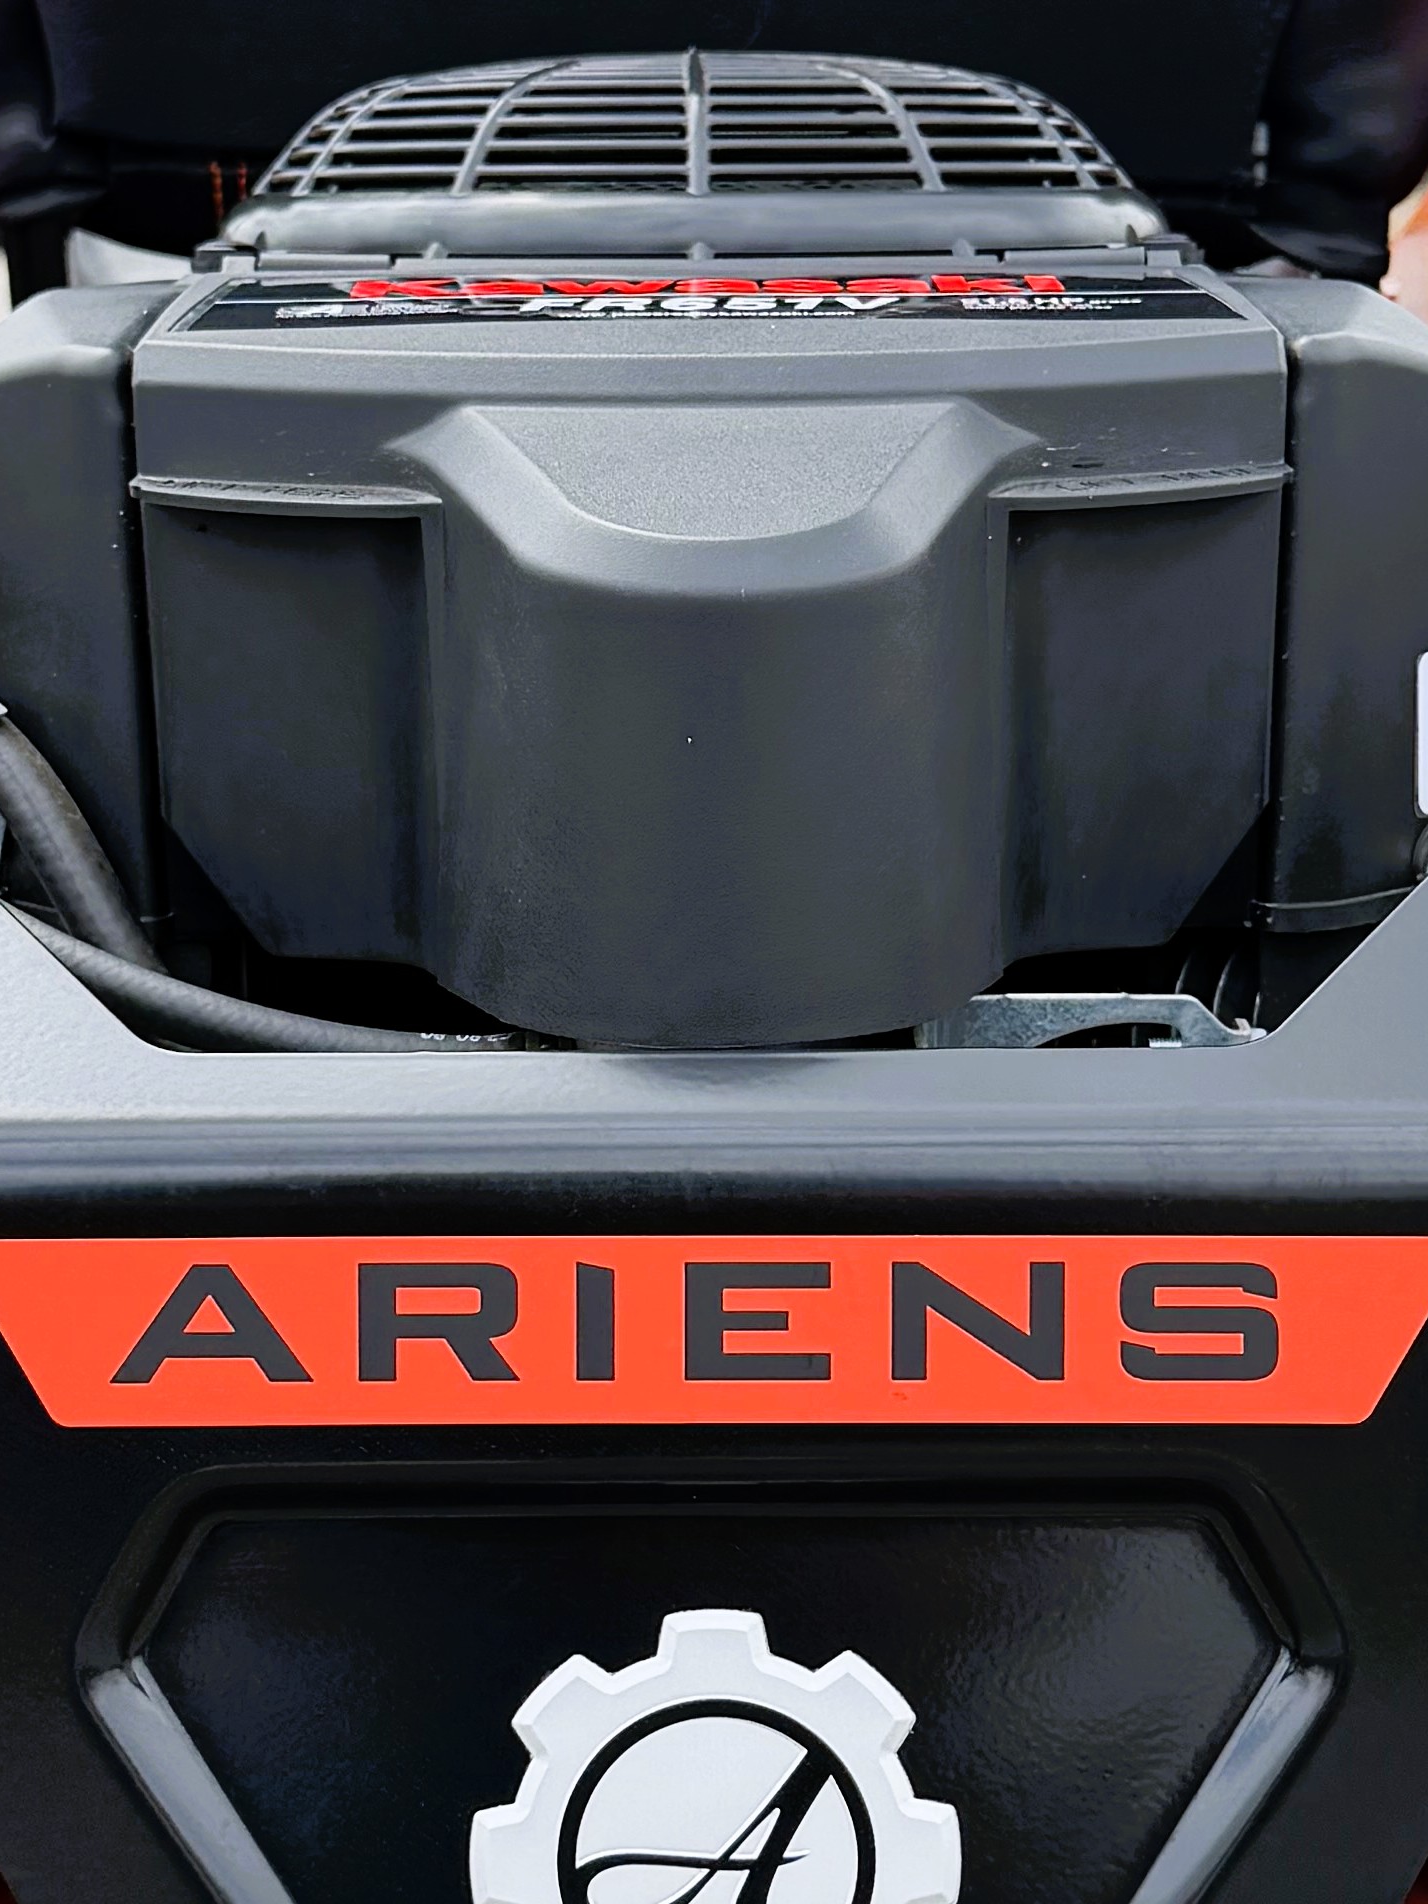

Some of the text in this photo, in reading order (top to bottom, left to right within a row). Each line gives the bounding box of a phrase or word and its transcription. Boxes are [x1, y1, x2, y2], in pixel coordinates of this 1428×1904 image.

[349, 274, 1066, 299] Kawasaki
[520, 297, 900, 312] FR651V
[108, 1260, 1280, 1383] ARIENS
